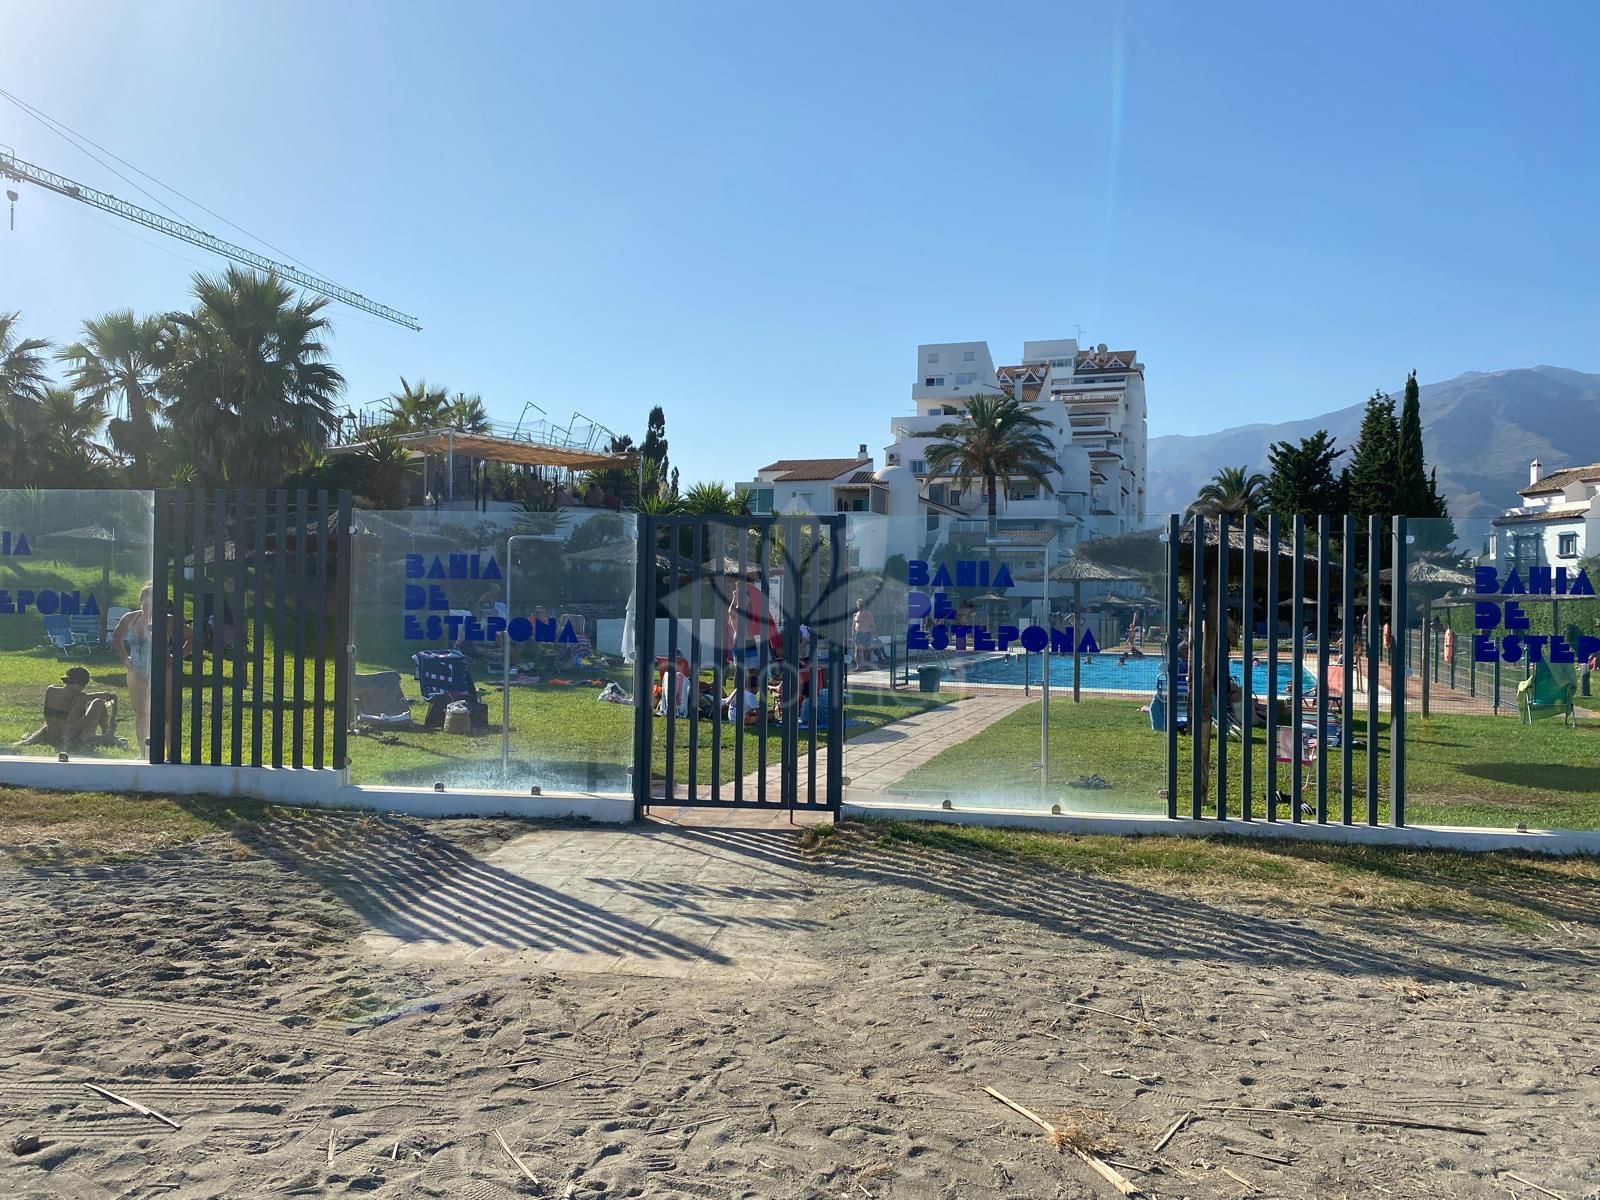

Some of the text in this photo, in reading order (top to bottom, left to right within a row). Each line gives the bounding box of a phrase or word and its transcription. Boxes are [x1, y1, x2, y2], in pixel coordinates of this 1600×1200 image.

[405, 553, 502, 579] BAHIA
[908, 560, 1015, 587] BAHIA
[1475, 566, 1596, 595] BAHIA
[405, 584, 449, 610] DE
[908, 591, 957, 619] DE
[404, 615, 578, 643] ESTEPONA
[1475, 601, 1529, 629] DE
[907, 624, 1100, 653] ESTEPONA
